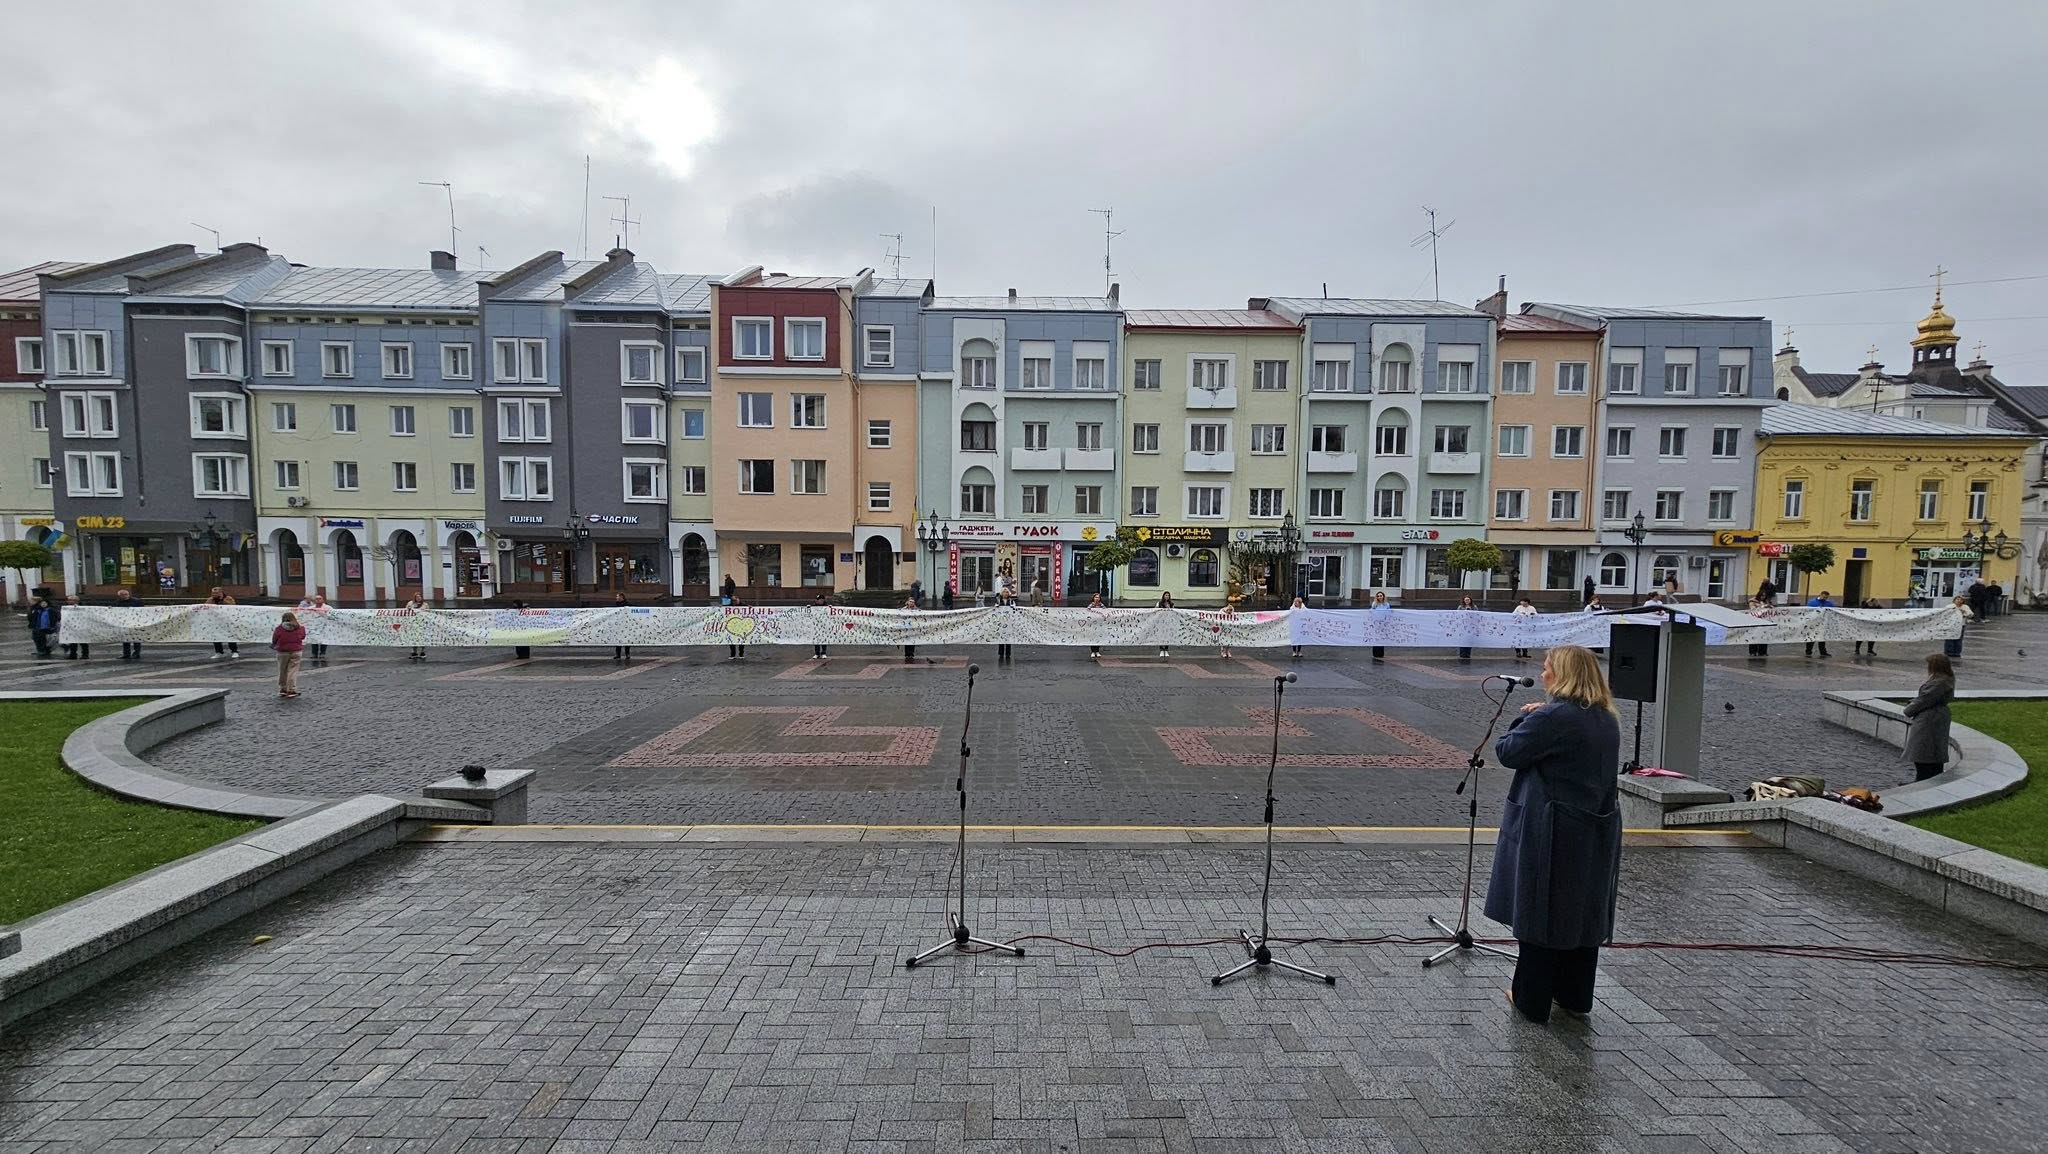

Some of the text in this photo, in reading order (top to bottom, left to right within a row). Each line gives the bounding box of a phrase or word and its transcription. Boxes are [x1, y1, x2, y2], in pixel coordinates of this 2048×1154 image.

[107, 516, 125, 528] 23
[602, 515, 638, 524] ЧАС ПІК
[444, 520, 476, 529] Vapors
[1014, 526, 1059, 537] ГУДОК
[376, 609, 417, 617] ВОЛИНЬ
[725, 607, 774, 616] ВОЛИНЬ
